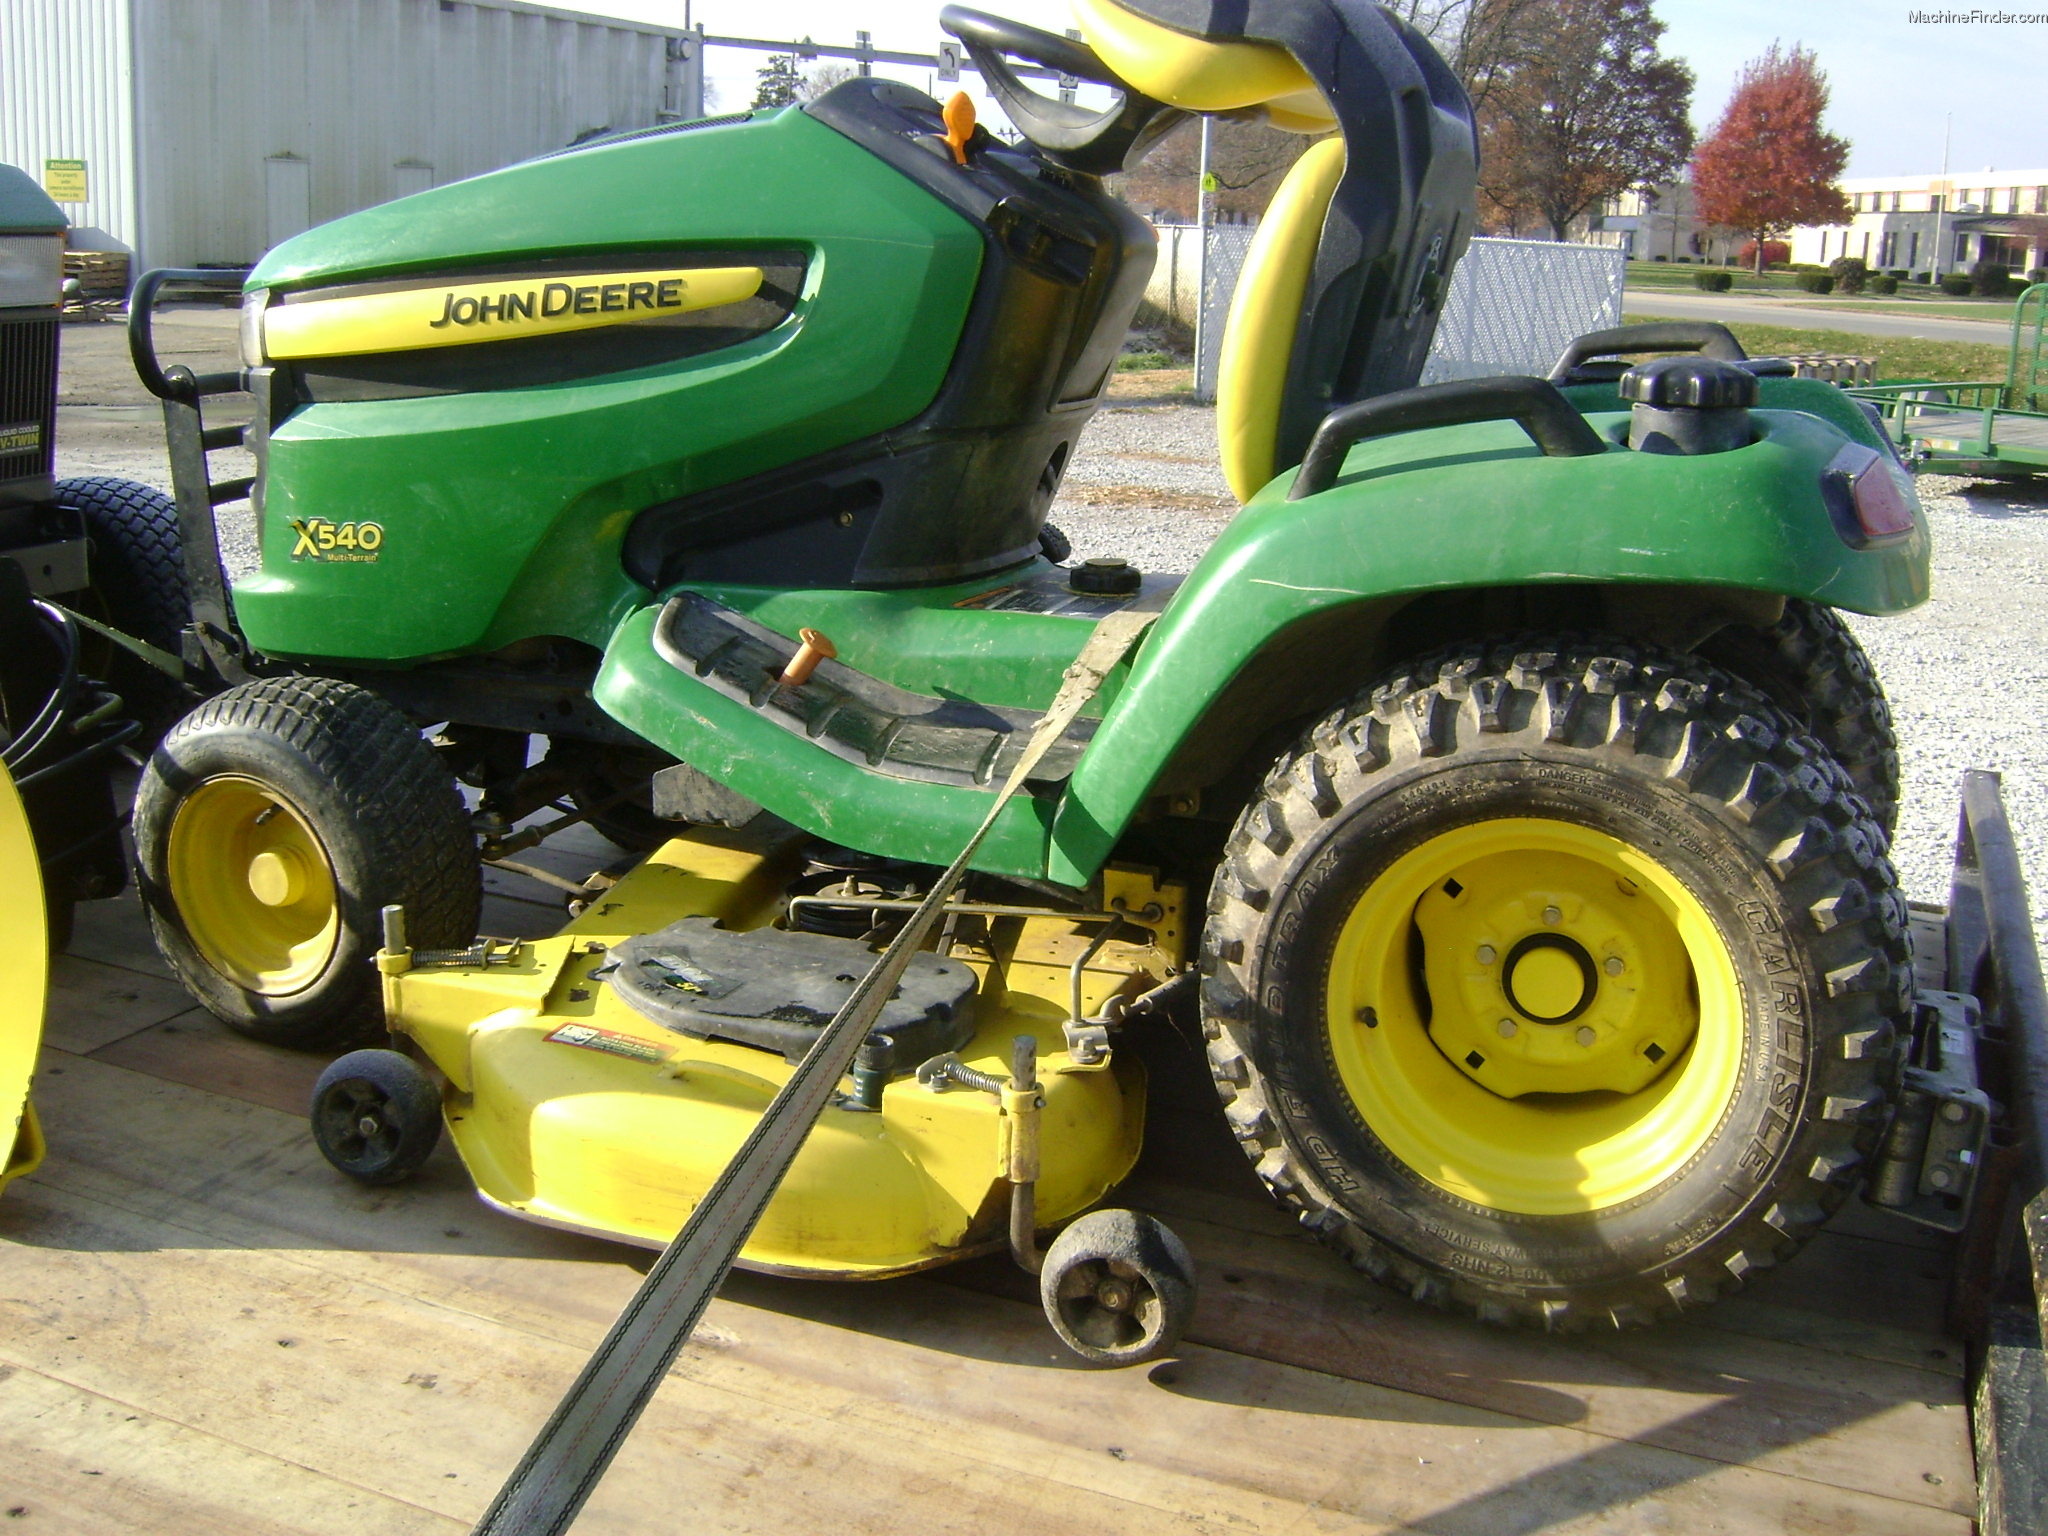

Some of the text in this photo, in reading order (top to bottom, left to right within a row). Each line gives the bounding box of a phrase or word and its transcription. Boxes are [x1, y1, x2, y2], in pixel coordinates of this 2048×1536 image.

[50, 161, 82, 170] Attention
[430, 278, 683, 329] JOHN DEERE
[288, 518, 381, 557] X540
[327, 553, 378, 562] Multi-Terrain
[1271, 846, 1339, 970] TRAX
[1758, 994, 1770, 1029] MADE
[624, 1034, 660, 1048] DANGER
[1738, 901, 1805, 1182] CARLISLE
[1760, 1034, 1770, 1047] IN
[1306, 1135, 1361, 1194] HD
[1433, 1224, 1491, 1253] SERVICE
